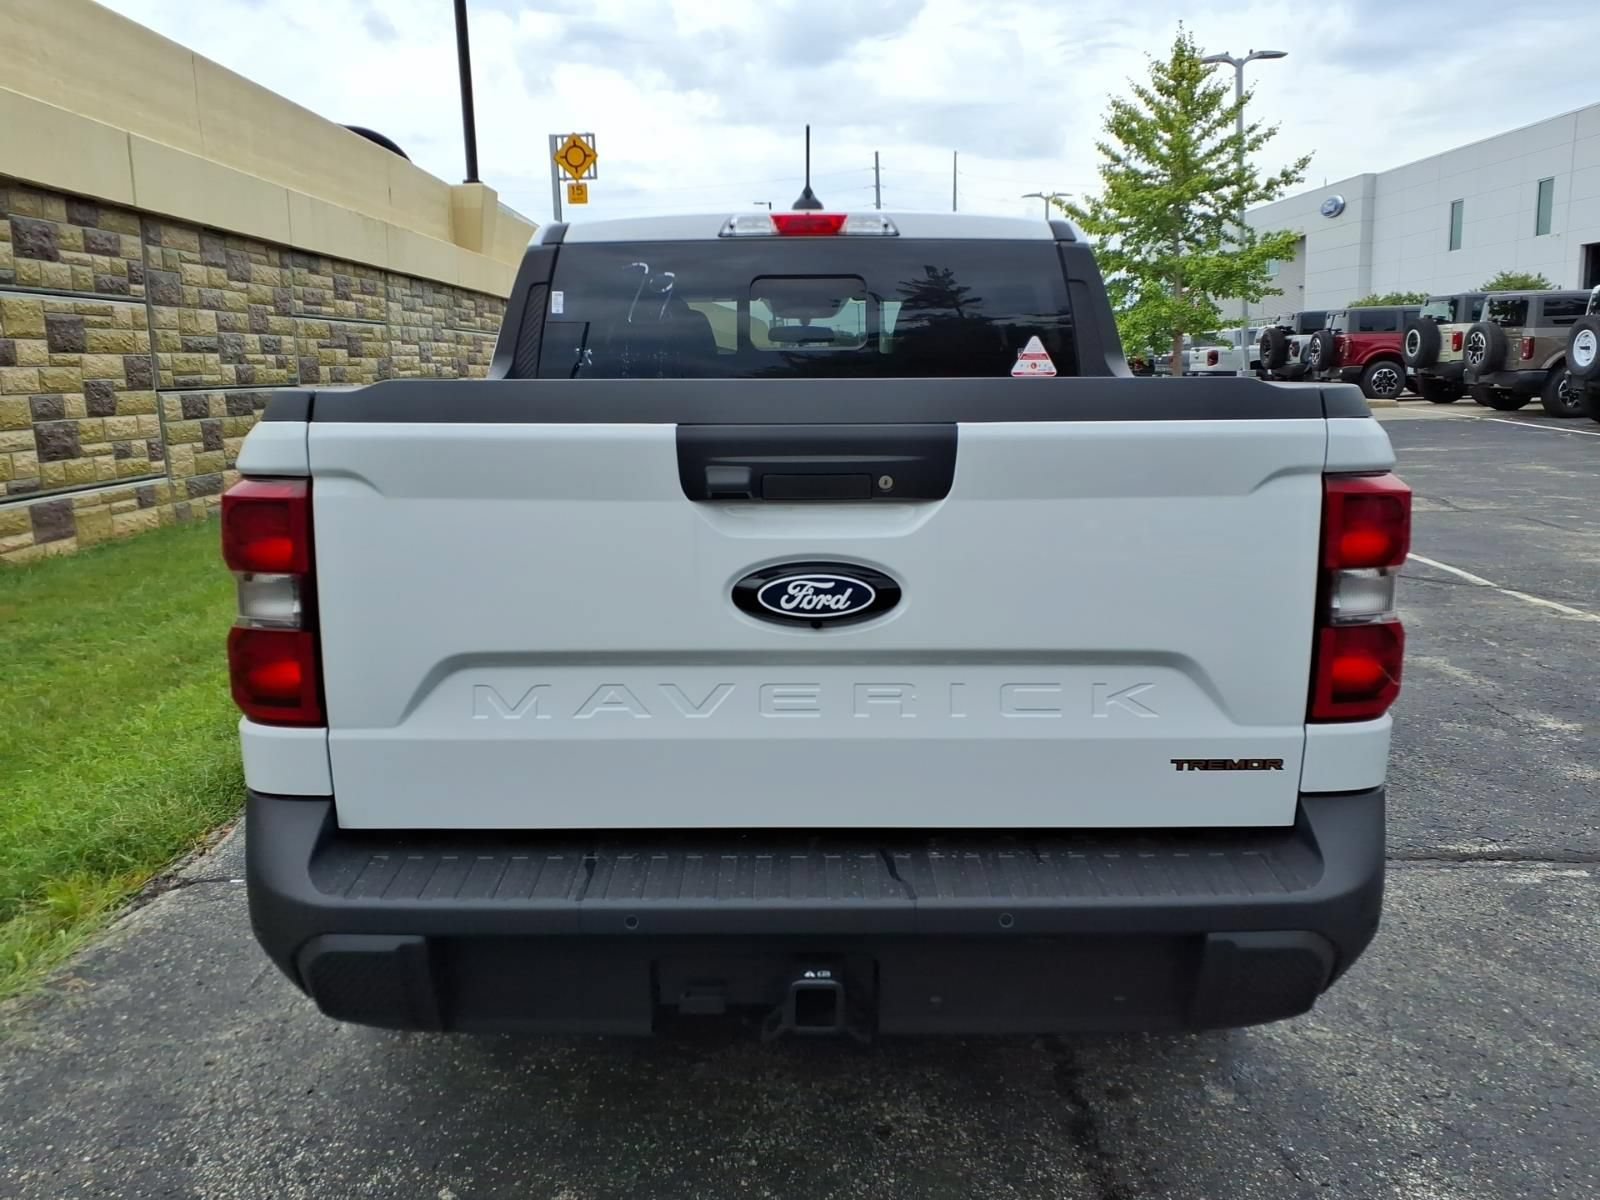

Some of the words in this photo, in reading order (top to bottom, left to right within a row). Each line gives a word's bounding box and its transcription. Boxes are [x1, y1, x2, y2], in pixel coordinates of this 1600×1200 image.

[571, 185, 584, 196] 15
[780, 580, 853, 610] Ford
[472, 682, 1160, 720] MAVERICK
[1170, 758, 1285, 771] TREMOR
